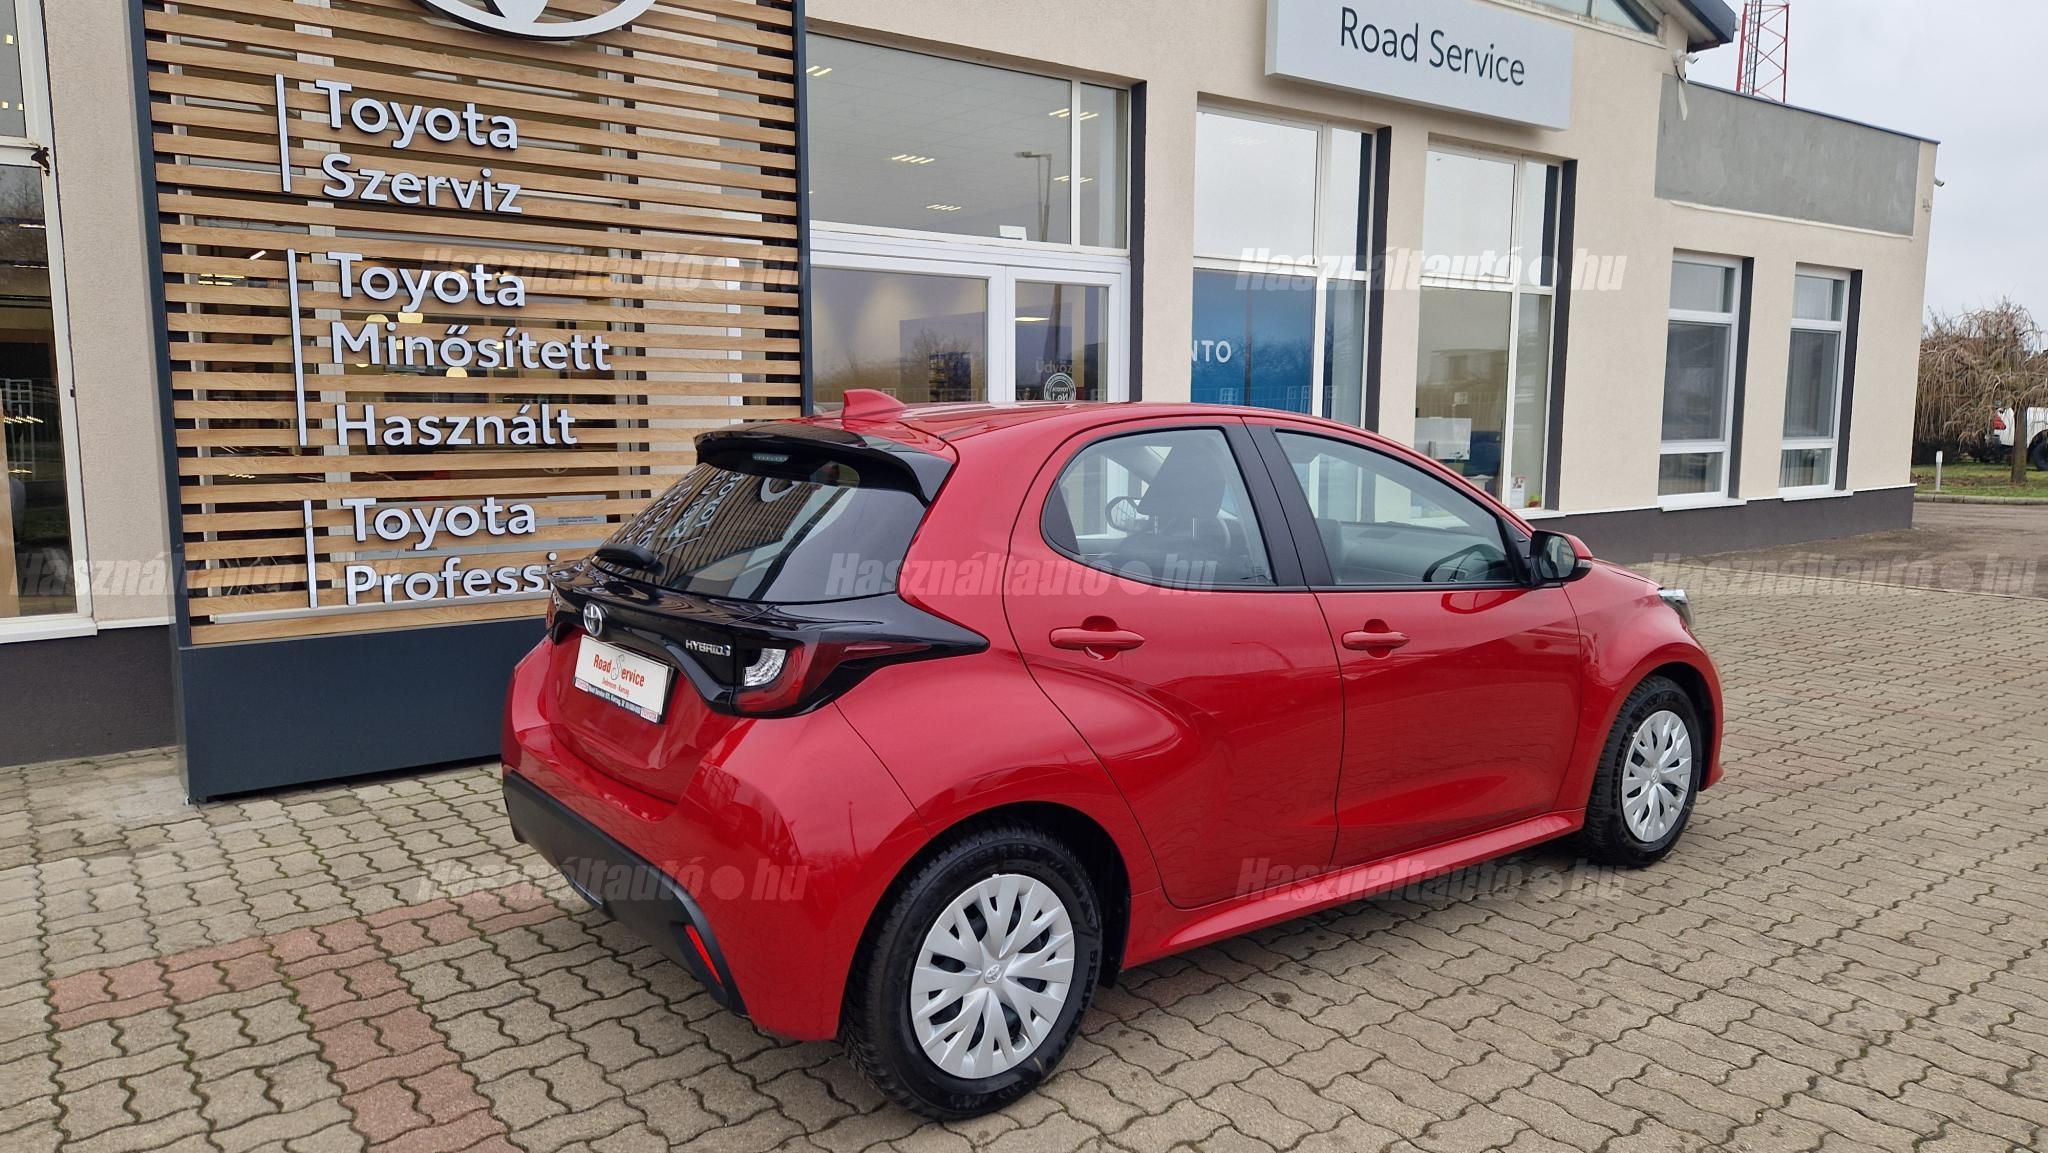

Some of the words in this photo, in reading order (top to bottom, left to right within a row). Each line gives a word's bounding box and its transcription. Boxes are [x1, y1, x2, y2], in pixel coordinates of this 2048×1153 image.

[1340, 6, 1420, 63] Road
[1429, 29, 1526, 86] Service
[314, 79, 519, 150] Toyota
[321, 152, 523, 213] Szerviz
[326, 251, 527, 312] Toyota
[330, 321, 613, 371] Minősített
[335, 403, 578, 447] Használt
[341, 496, 537, 551] Toyota
[593, 653, 612, 674] Road
[685, 639, 725, 656] HYBRID
